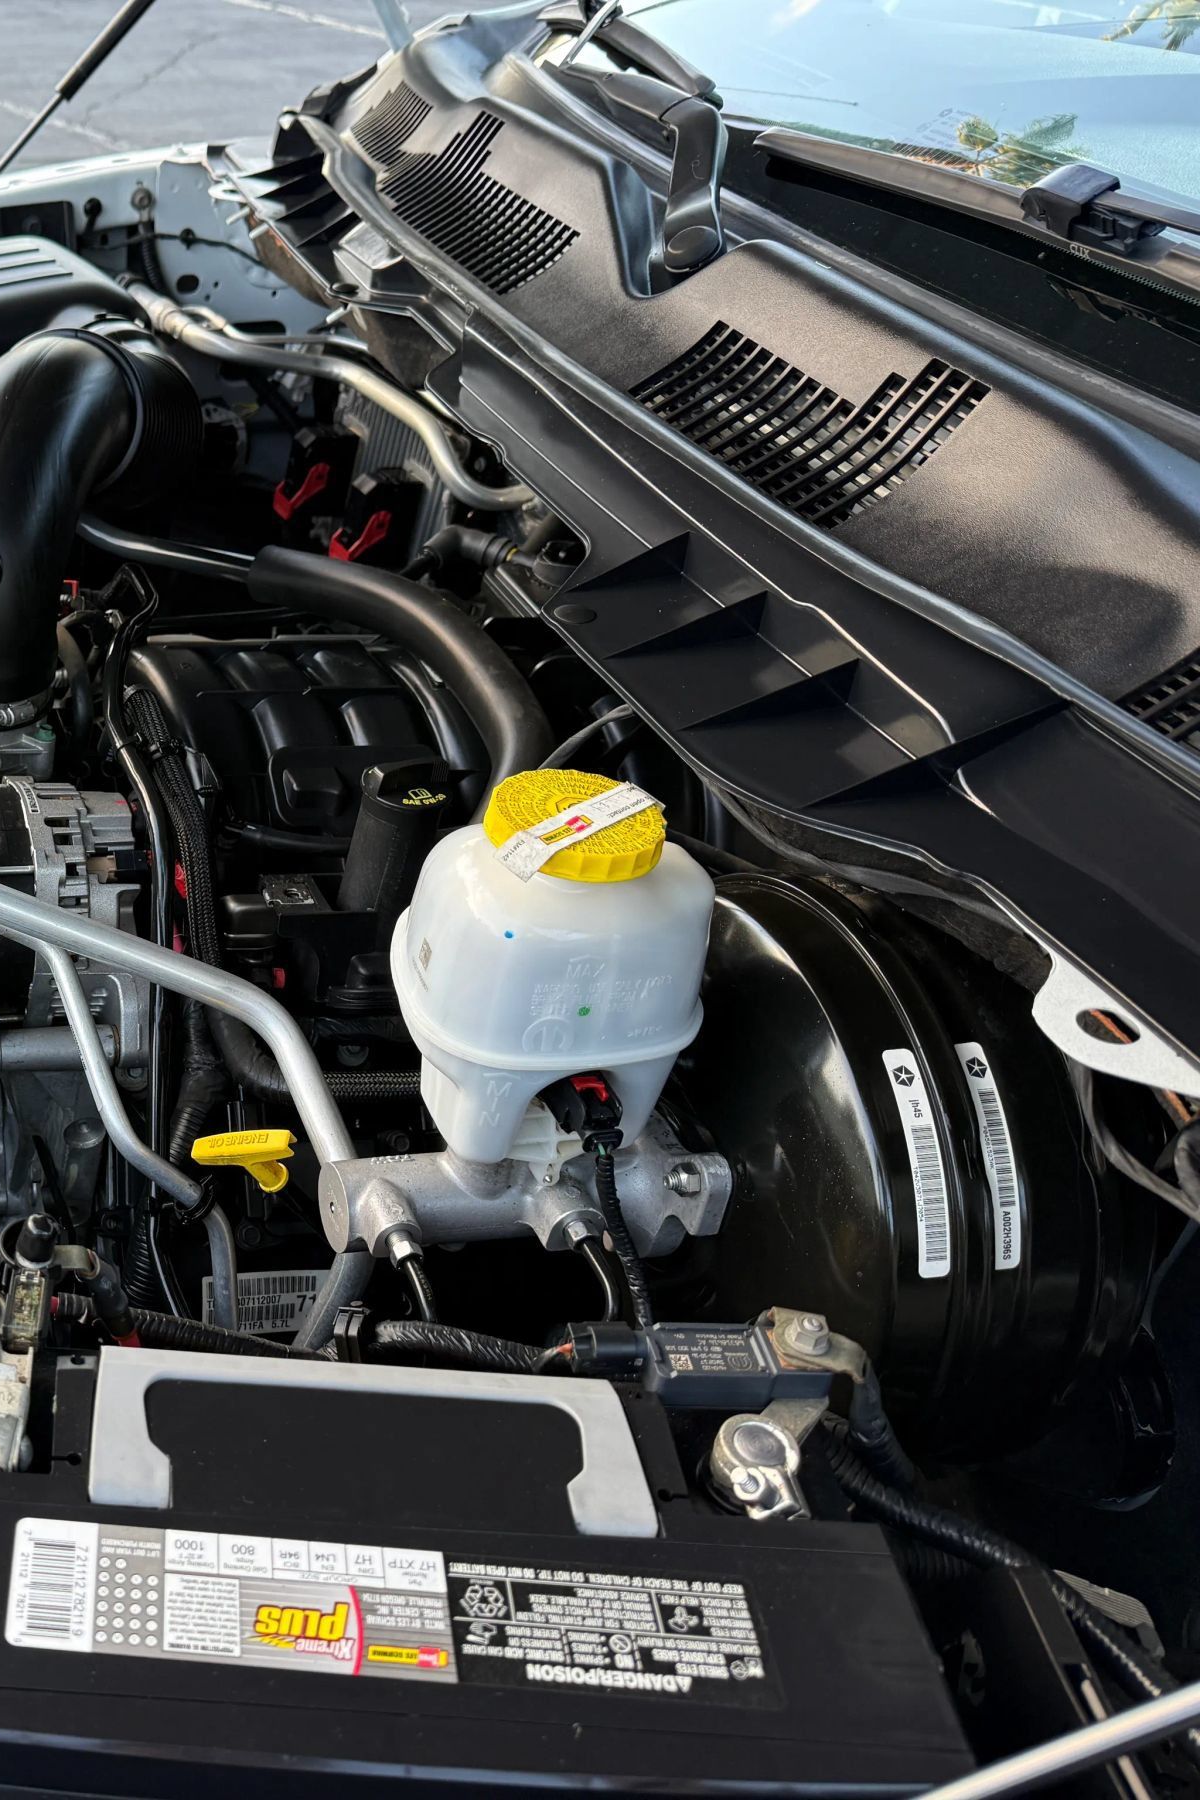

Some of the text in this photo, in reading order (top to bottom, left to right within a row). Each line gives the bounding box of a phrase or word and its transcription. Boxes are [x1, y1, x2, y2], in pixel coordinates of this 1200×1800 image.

[1069, 243, 1089, 257] CLIX
[207, 1130, 268, 1149] ENGINE OIL
[1002, 1210, 1012, 1260] A002H396S
[174, 1538, 204, 1550] 1000
[231, 1543, 255, 1555] 800
[279, 1549, 299, 1559] 94R
[354, 1553, 372, 1564] H7
[19, 1552, 29, 1577] 21112
[187, 1559, 214, 1568] Cranking
[222, 1562, 251, 1571] Cranking
[387, 1558, 436, 1570] H7 XTP
[74, 1555, 87, 1588] 21112
[486, 1565, 506, 1576] OPEN
[507, 1567, 522, 1577] NOT
[522, 1568, 535, 1578] DO
[553, 1570, 570, 1581] NOT
[322, 1574, 358, 1583] GROUP
[408, 1578, 421, 1586] Part
[571, 1572, 584, 1582] DO
[631, 1576, 642, 1586] OF
[643, 1577, 671, 1588] REACH
[672, 1579, 689, 1589] THE
[690, 1581, 703, 1590] OF
[703, 1581, 721, 1592] OUT
[721, 1582, 744, 1594] KEEP
[679, 1595, 698, 1605] HELP
[698, 1596, 731, 1608] MEDICAL
[732, 1599, 747, 1608] GET
[15, 1593, 25, 1619] 78211
[72, 1591, 85, 1625] 78211
[365, 1614, 395, 1625] SCHWAB
[709, 1627, 755, 1638] FLUSH EYES
[294, 1634, 354, 1660] Xtreme
[461, 1643, 487, 1654] CAUSE
[486, 1645, 502, 1656] CAN
[675, 1639, 717, 1652] BLINDNESS
[717, 1642, 742, 1654] CAUSE
[742, 1644, 760, 1655] CAN
[503, 1646, 524, 1658] ACID
[651, 1648, 725, 1664] EXPLOSIVE GASES
[613, 1653, 634, 1668] NO
[674, 1662, 728, 1678] SHIELD EYES
[524, 1662, 677, 1692] DANGER/POISON
